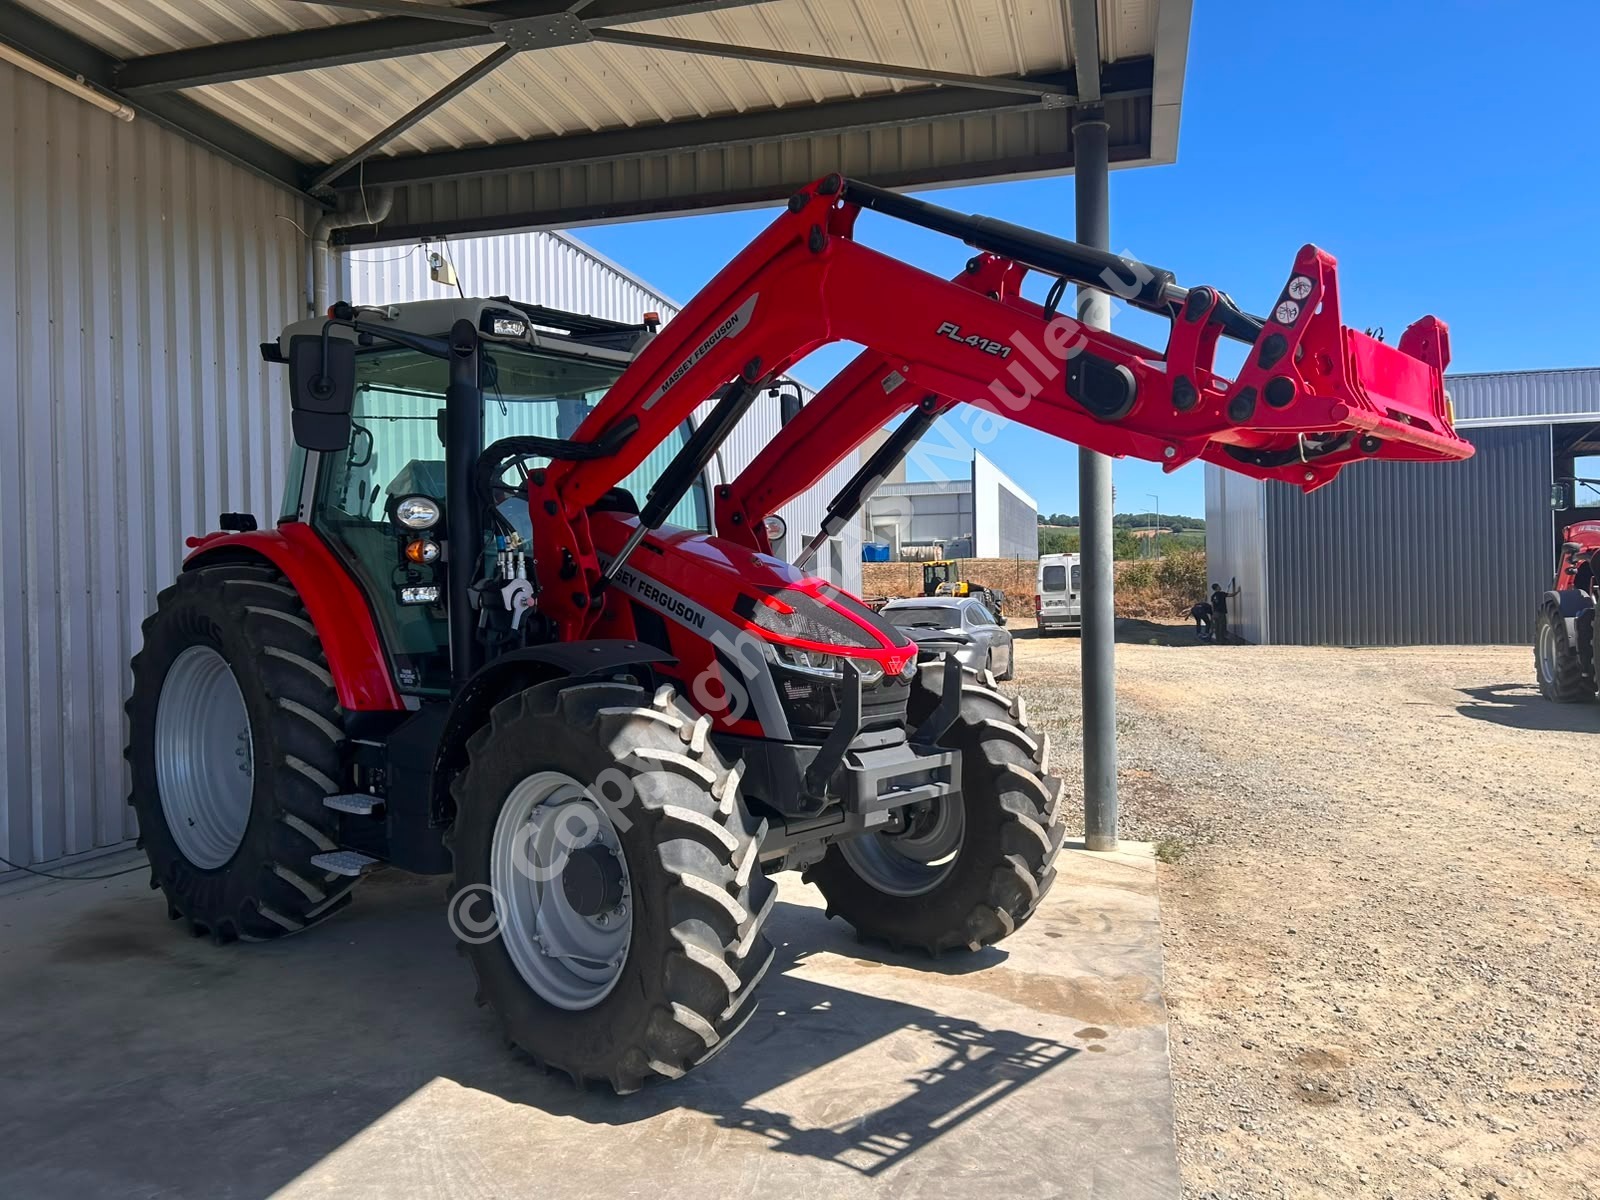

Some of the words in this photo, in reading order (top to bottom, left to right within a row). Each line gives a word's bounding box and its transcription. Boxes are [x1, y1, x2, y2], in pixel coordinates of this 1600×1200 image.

[661, 357, 693, 393] MASSEY
[693, 313, 740, 360] FERGUSON
[936, 320, 1012, 359] FL.4121
[637, 579, 706, 629] FERGUSON
